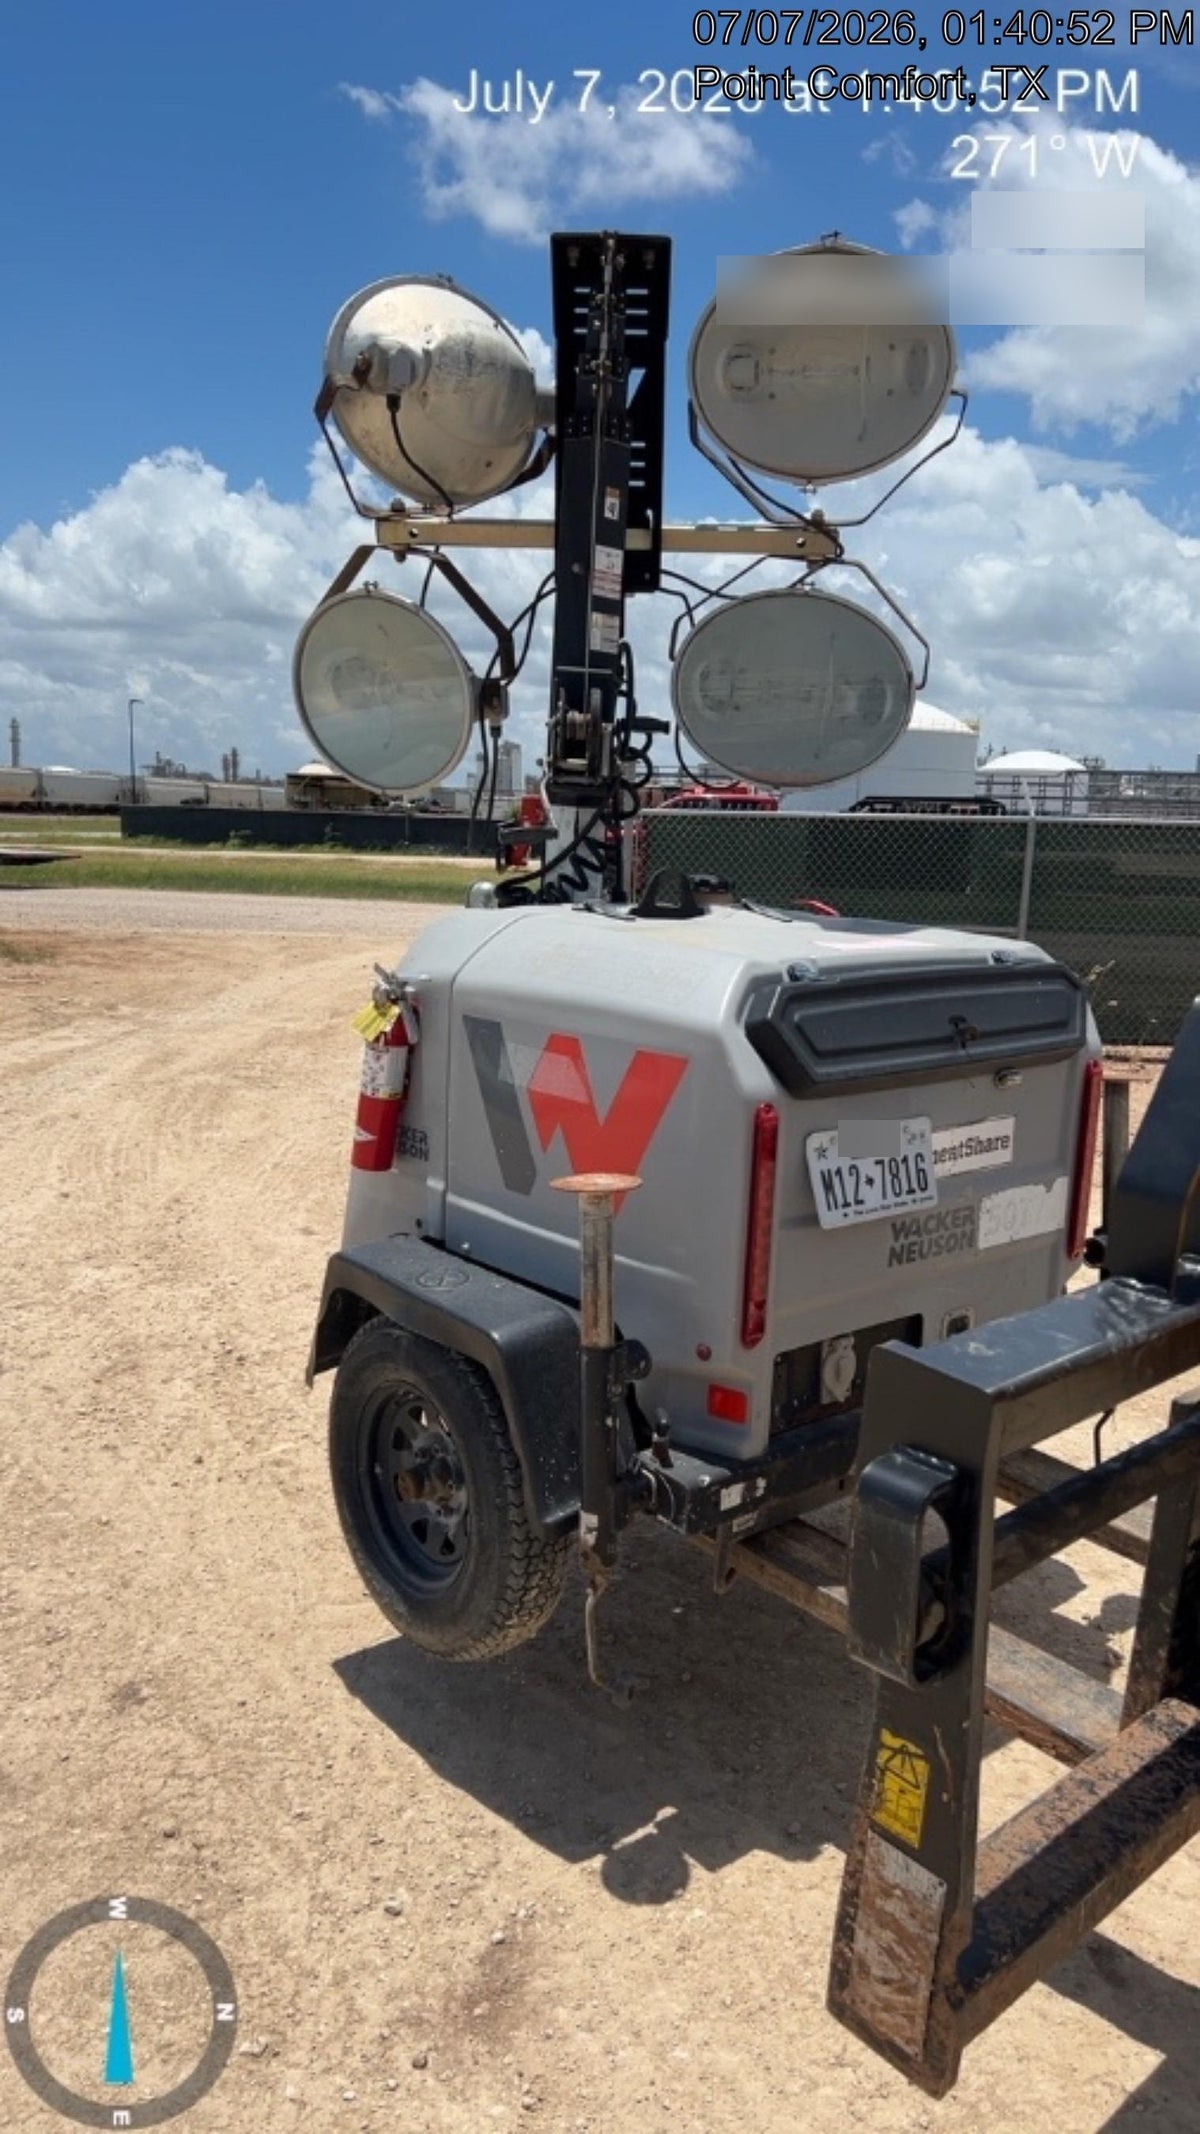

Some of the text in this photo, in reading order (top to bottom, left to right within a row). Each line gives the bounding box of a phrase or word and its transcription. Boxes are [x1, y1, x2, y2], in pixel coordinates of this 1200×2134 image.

[932, 1134, 1012, 1165] entShare
[890, 1205, 976, 1244] WACKER
[887, 1227, 977, 1268] NEUSON
